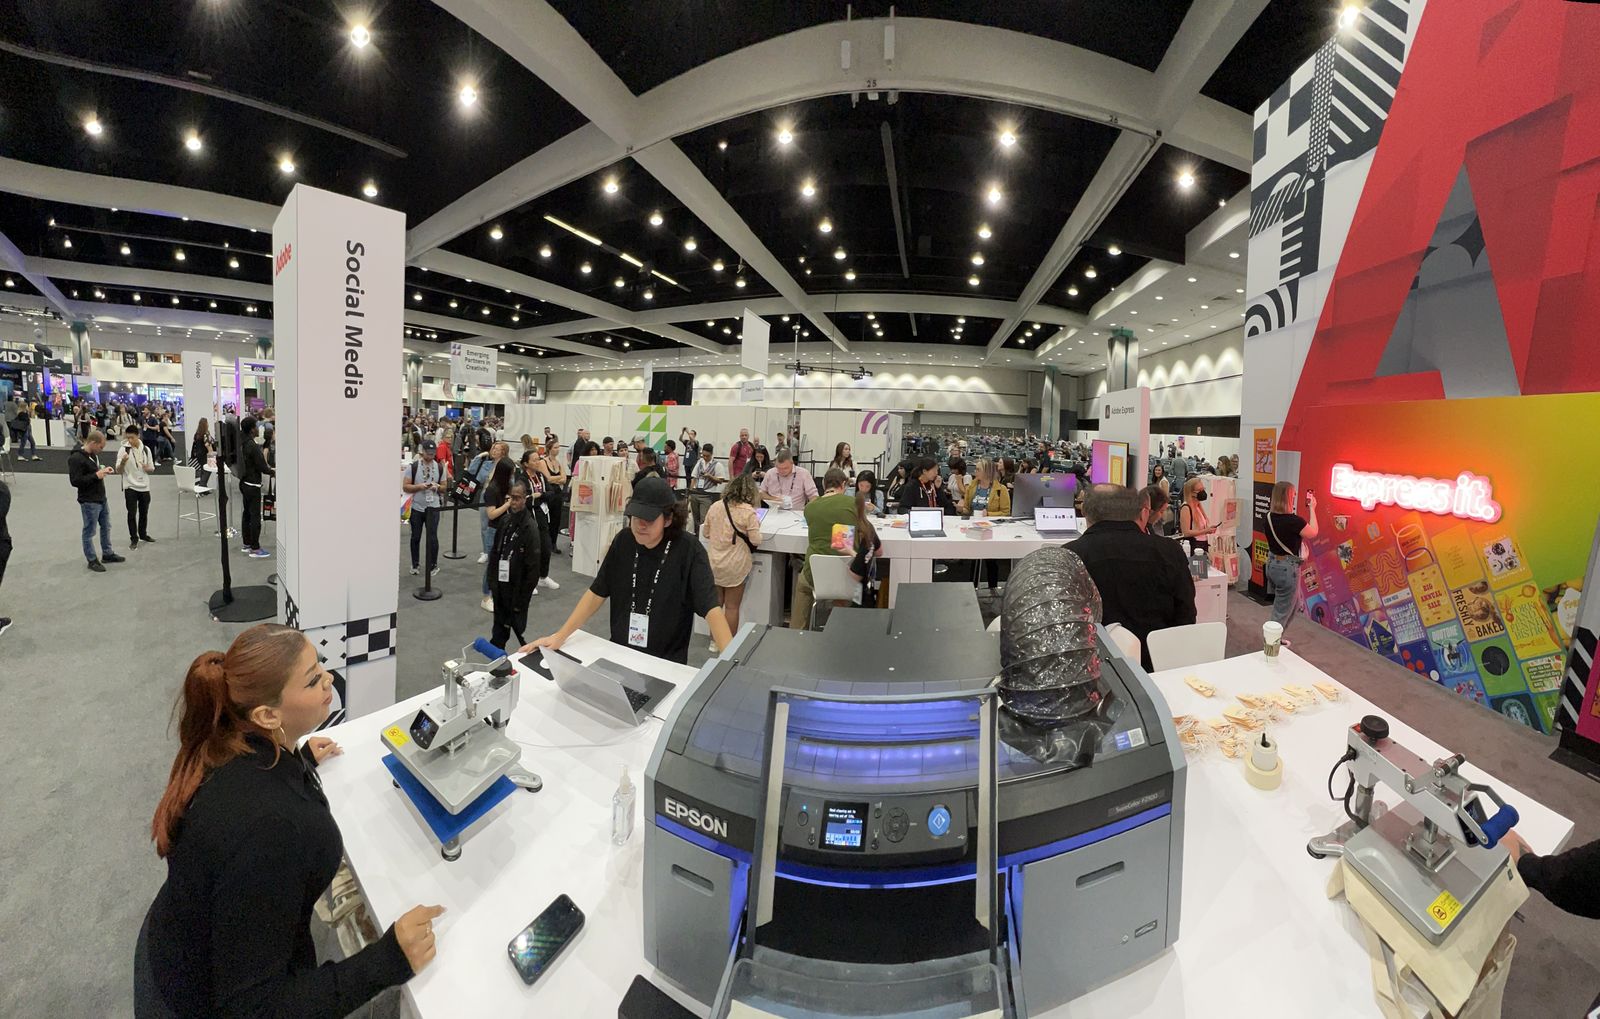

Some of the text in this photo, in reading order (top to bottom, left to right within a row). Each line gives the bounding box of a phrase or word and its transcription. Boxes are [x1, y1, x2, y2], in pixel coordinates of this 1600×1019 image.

[275, 243, 292, 276] Adobe
[344, 240, 365, 400] Social Media
[464, 356, 486, 365] Partners
[466, 350, 490, 360] Emerging
[466, 364, 489, 373] Creativity
[1330, 464, 1498, 521] Express it.
[1422, 584, 1433, 592] BIG
[1421, 590, 1442, 602] ANNUAL
[1428, 600, 1441, 609] SALE
[1453, 590, 1474, 626] FRESHLY
[1476, 622, 1505, 638] BAKED
[664, 798, 728, 838] EPSON
